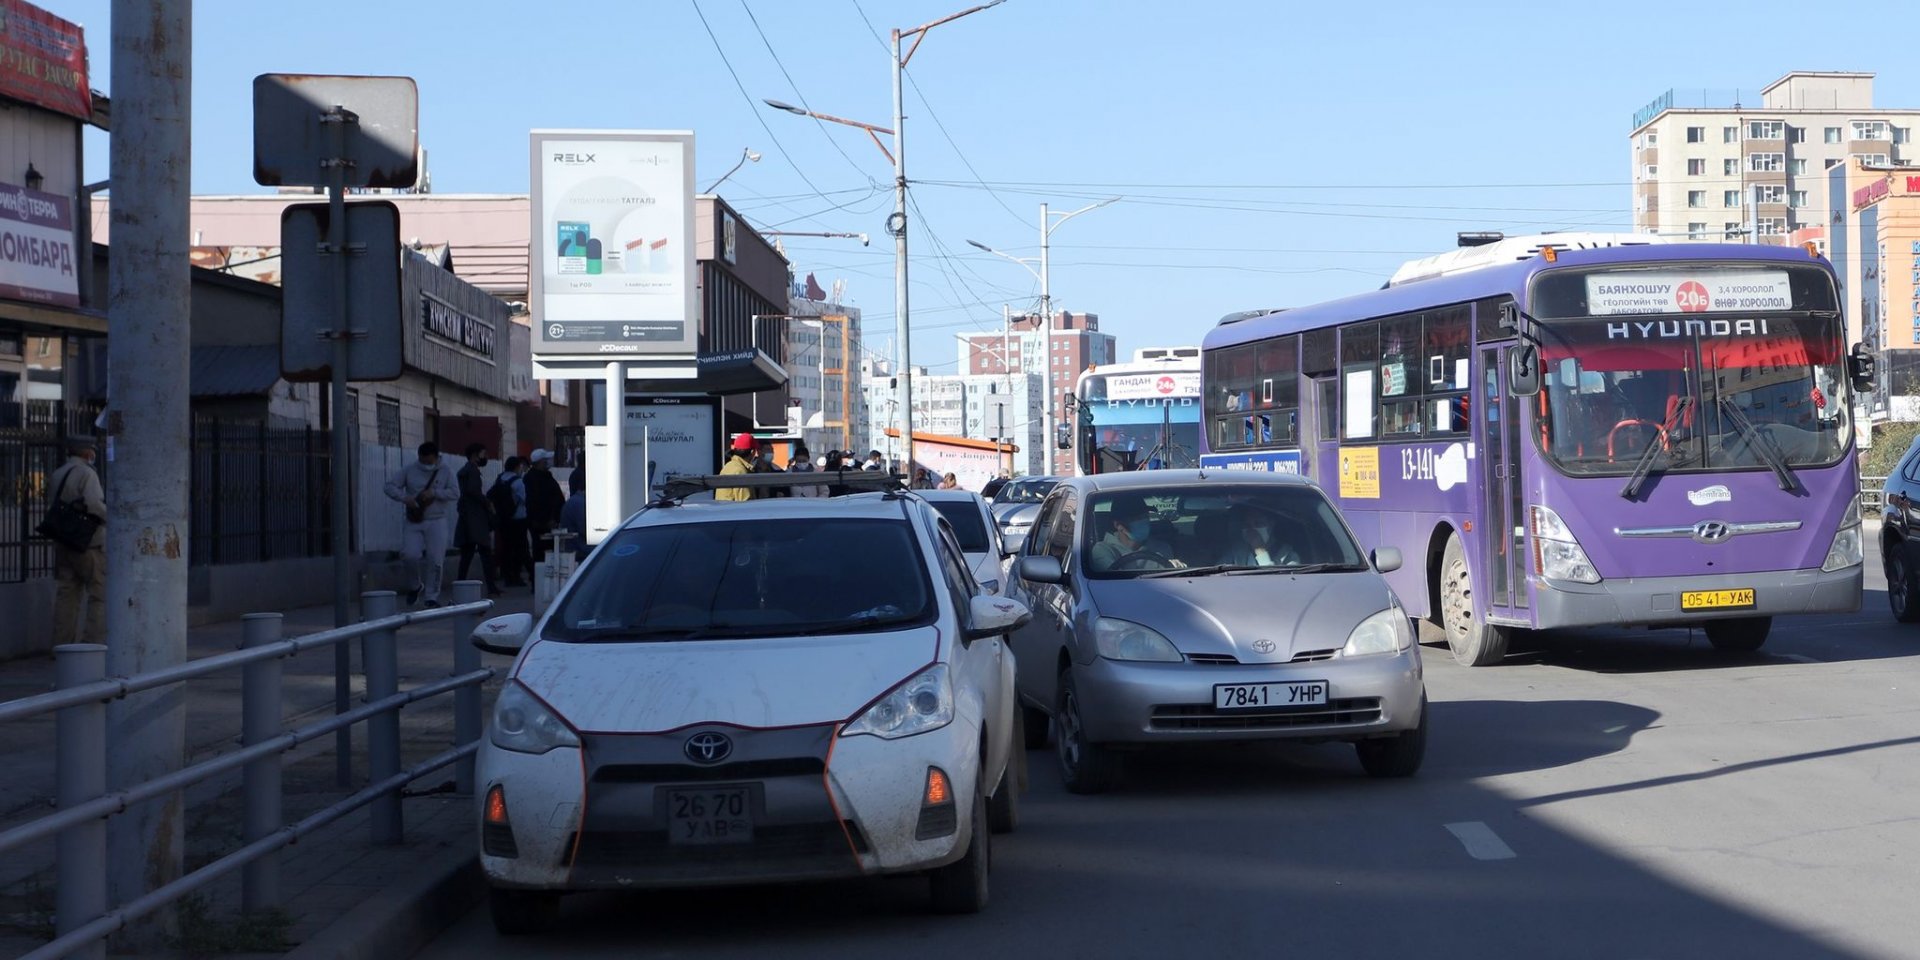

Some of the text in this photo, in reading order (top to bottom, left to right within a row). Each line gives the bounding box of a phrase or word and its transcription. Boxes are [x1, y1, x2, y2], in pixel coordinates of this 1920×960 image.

[553, 153, 596, 163] RELX
[0, 230, 73, 277] ОМБАРД
[1598, 284, 1672, 295] БАЯНХОШУУ
[1718, 286, 1731, 295] 3,4
[1732, 285, 1775, 294] ХОРООЛОЛ
[1603, 297, 1786, 308] ГЕОЛОГИЙН ТӨВ ӨНӨР ХОРООЛОЛ
[1607, 319, 1768, 339] HYUNDAI
[733, 351, 754, 360] ХИЙД
[1114, 378, 1151, 386] ГАНДАН
[1401, 447, 1433, 480] 13-141
[1688, 591, 1751, 607] 05 41 УАК
[1224, 685, 1322, 706] 7841 УНР
[674, 793, 743, 819] 26 70
